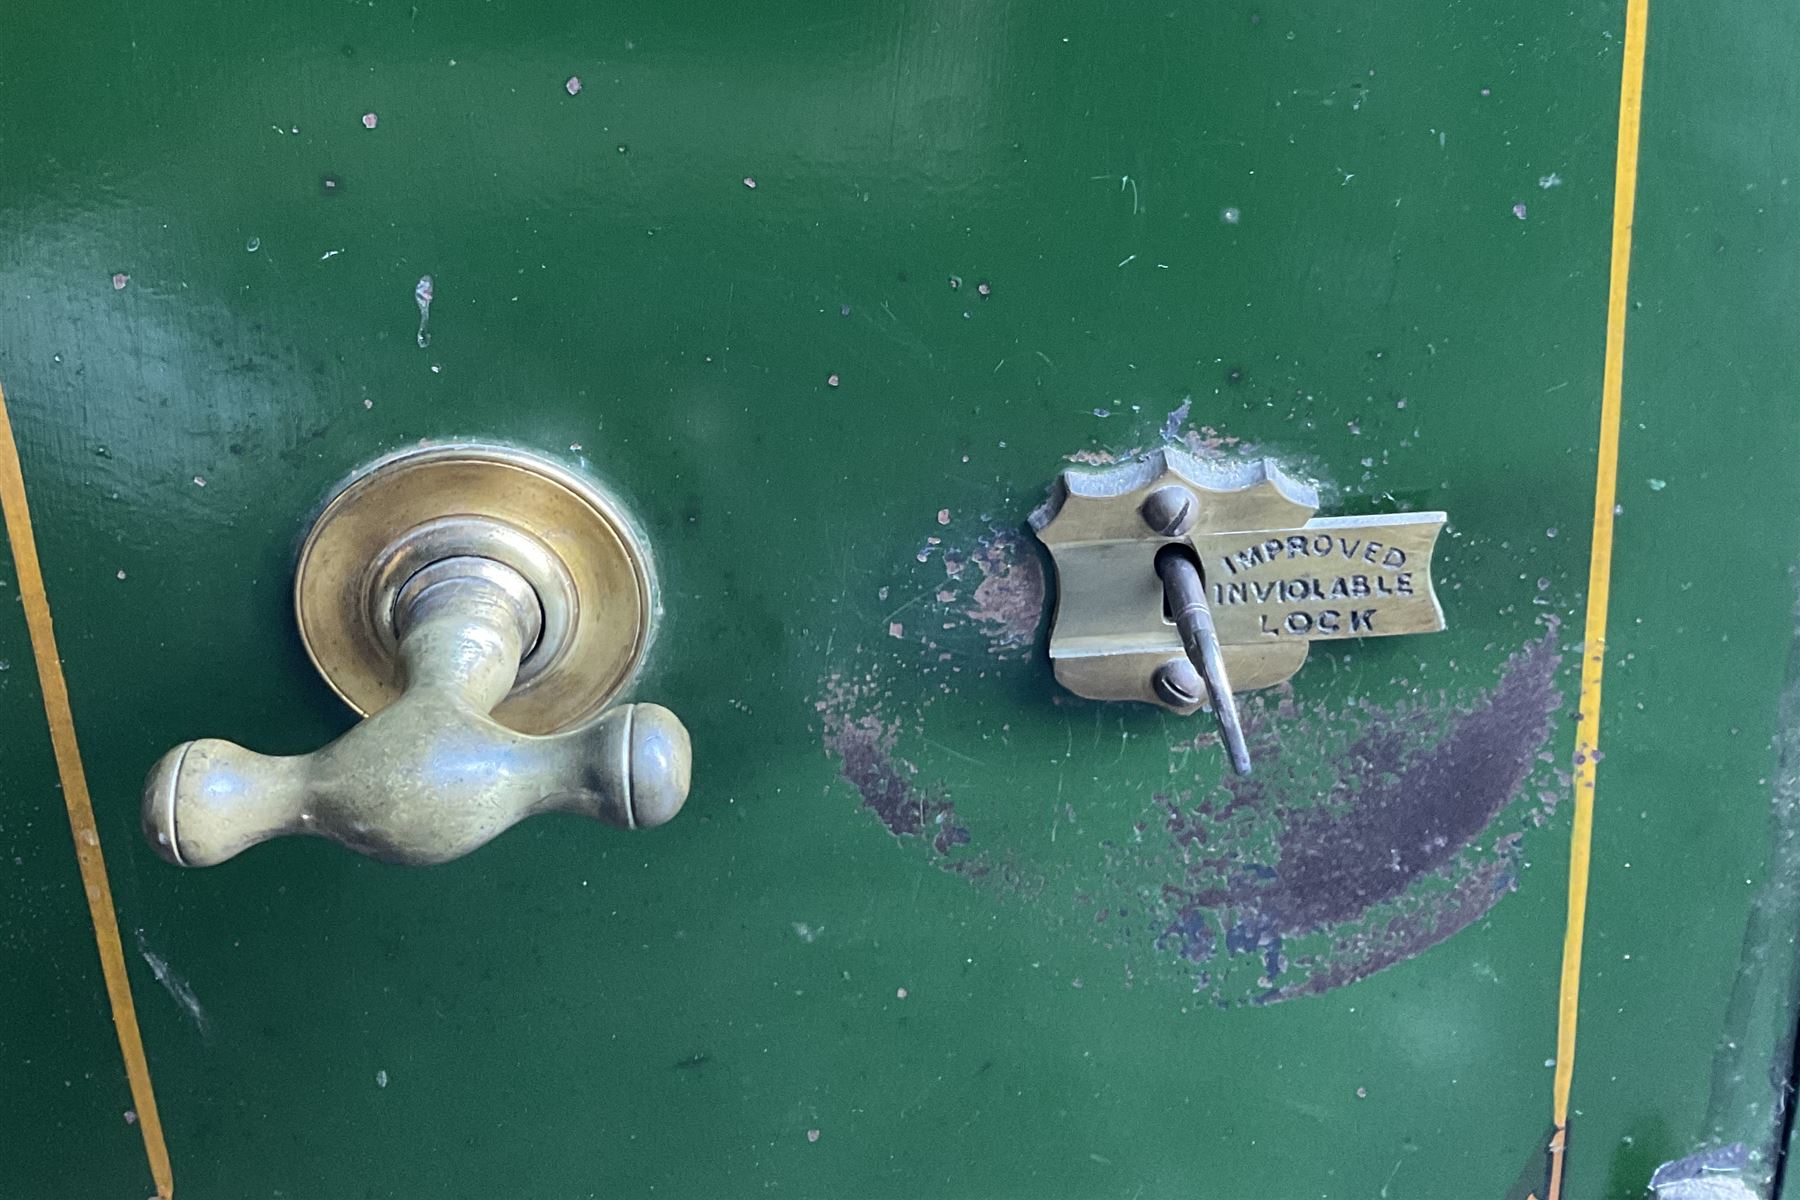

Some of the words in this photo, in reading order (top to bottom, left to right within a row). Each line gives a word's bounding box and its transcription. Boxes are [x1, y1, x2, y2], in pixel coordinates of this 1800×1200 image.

[1221, 534, 1407, 575] IMPROVED
[1214, 572, 1414, 605] INVIOLABLE
[1259, 609, 1377, 636] LOCK
